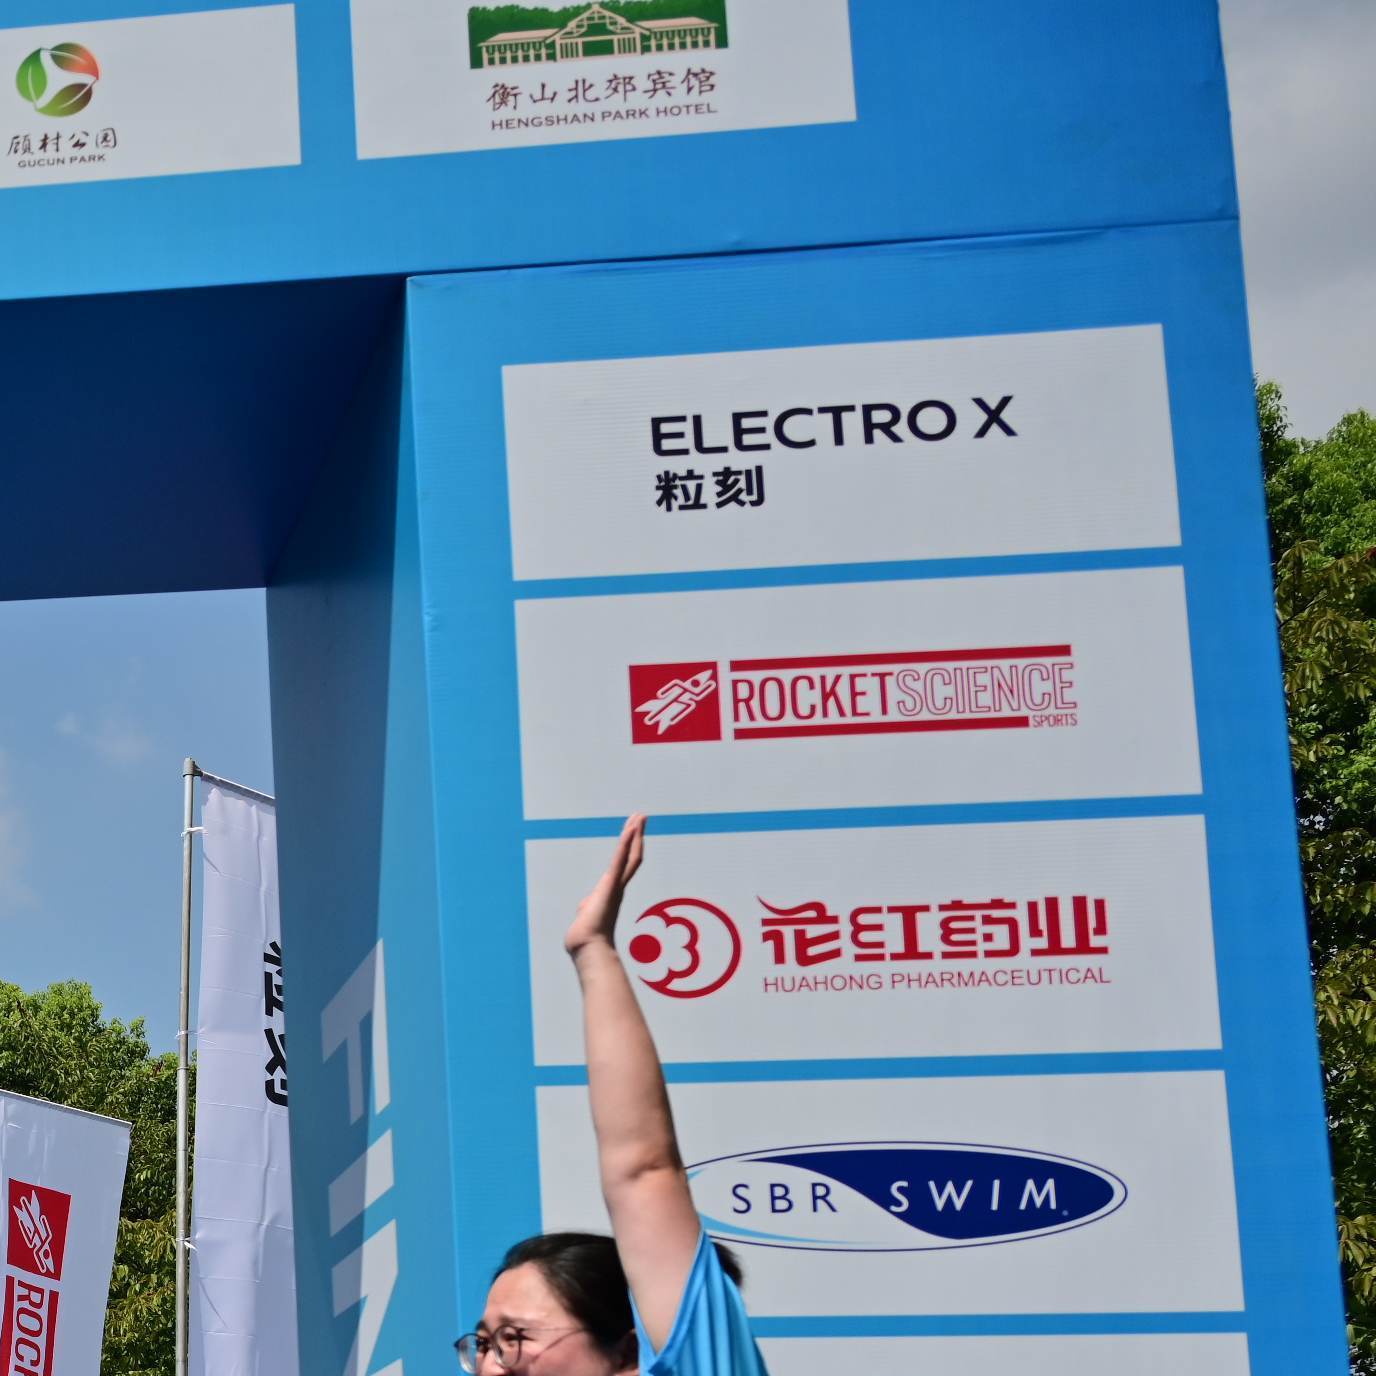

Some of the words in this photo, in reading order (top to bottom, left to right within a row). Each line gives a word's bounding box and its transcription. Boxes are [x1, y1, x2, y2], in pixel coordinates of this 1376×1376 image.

[487, 67, 717, 112] 衡山北郊宾馆
[491, 112, 595, 130] HENGSHAN
[601, 107, 650, 122] PARK
[656, 102, 718, 117] HOTEL
[7, 127, 118, 156] 顾村公园
[18, 155, 66, 168] GUCUN
[70, 153, 106, 165] PARK
[650, 399, 957, 458] ELECTRO
[970, 395, 1018, 438] X
[654, 465, 766, 513] 粒刻
[1032, 710, 1078, 728] SPORTS
[762, 971, 884, 994] HUAHONG
[889, 963, 1112, 990] PHARMACEUTICAL
[731, 1182, 839, 1215] SBR
[889, 1177, 1059, 1212] SWIM
